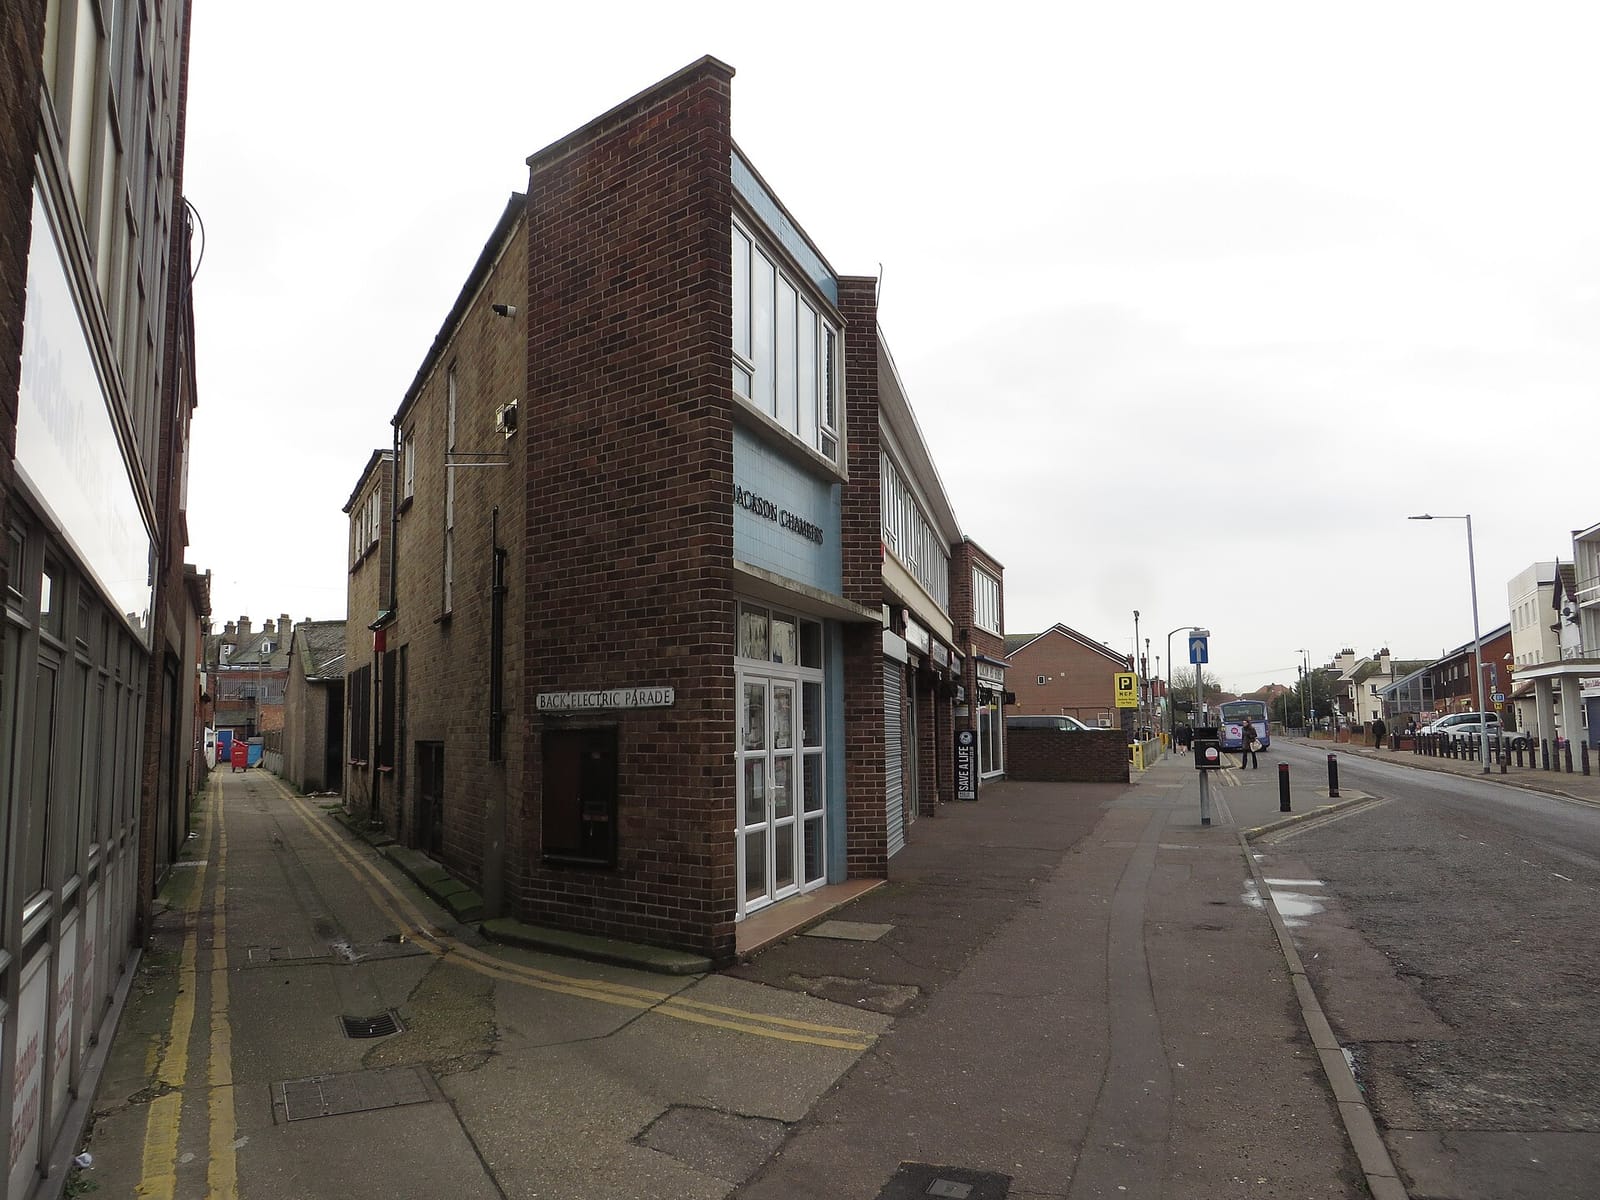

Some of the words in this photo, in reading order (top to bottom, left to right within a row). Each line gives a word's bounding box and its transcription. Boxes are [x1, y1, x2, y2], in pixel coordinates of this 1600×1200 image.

[779, 509, 824, 545] CHAMBERS
[1121, 678, 1130, 689] P
[540, 694, 566, 709] BACK
[571, 692, 621, 707] ELECTRIC
[625, 689, 670, 706] PARADE
[958, 746, 969, 762] LIFE
[958, 771, 969, 791] SAVE
